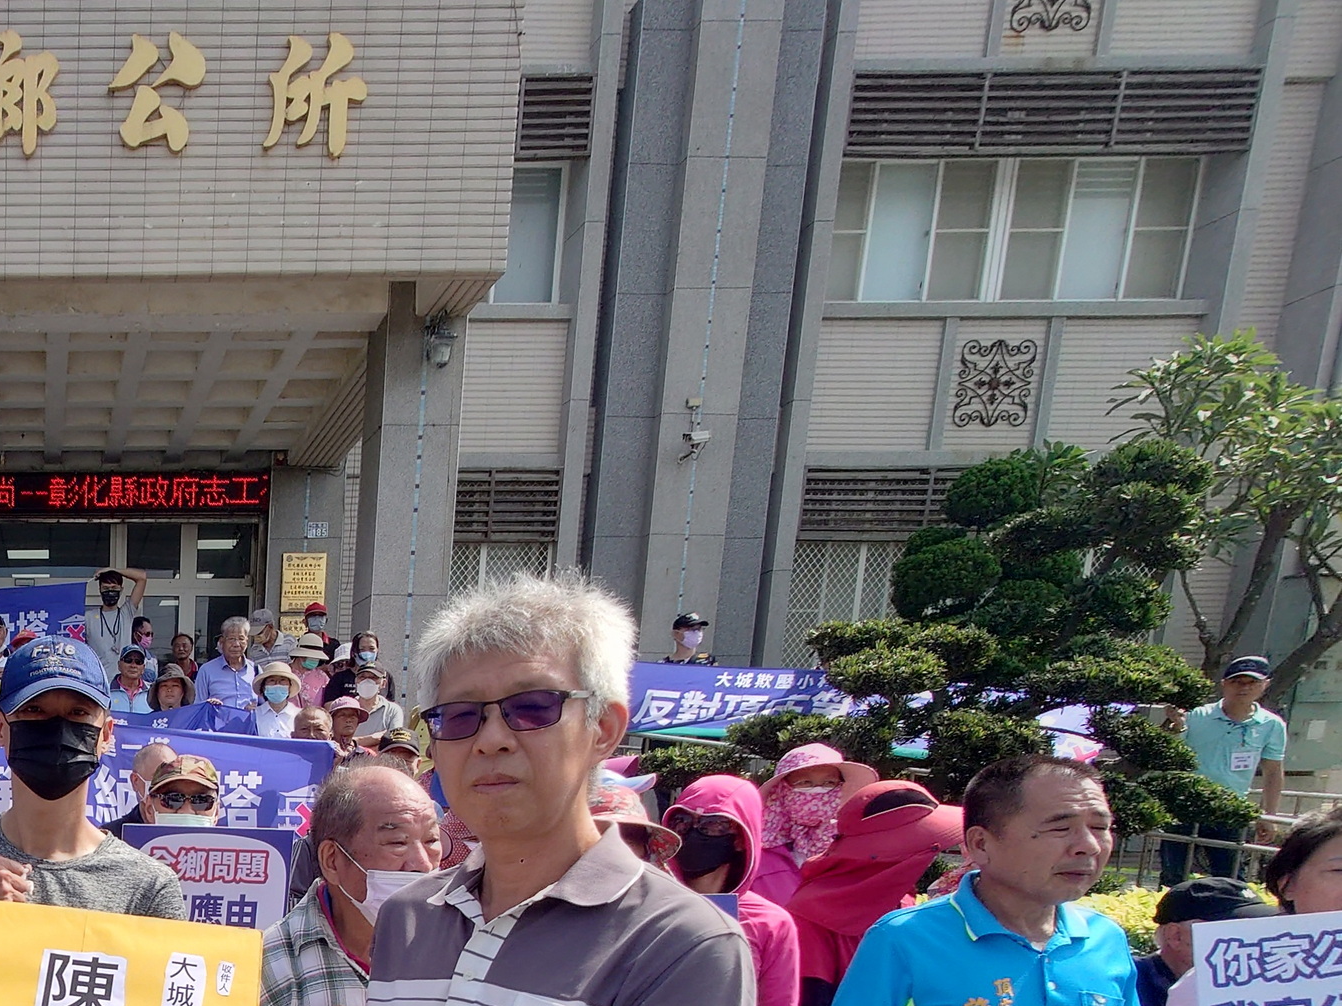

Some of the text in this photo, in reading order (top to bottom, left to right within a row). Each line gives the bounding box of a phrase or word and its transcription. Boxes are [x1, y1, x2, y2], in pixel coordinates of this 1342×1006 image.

[32, 642, 76, 658] F-16
[182, 893, 258, 929] 應由
[220, 963, 233, 994] 收件人
